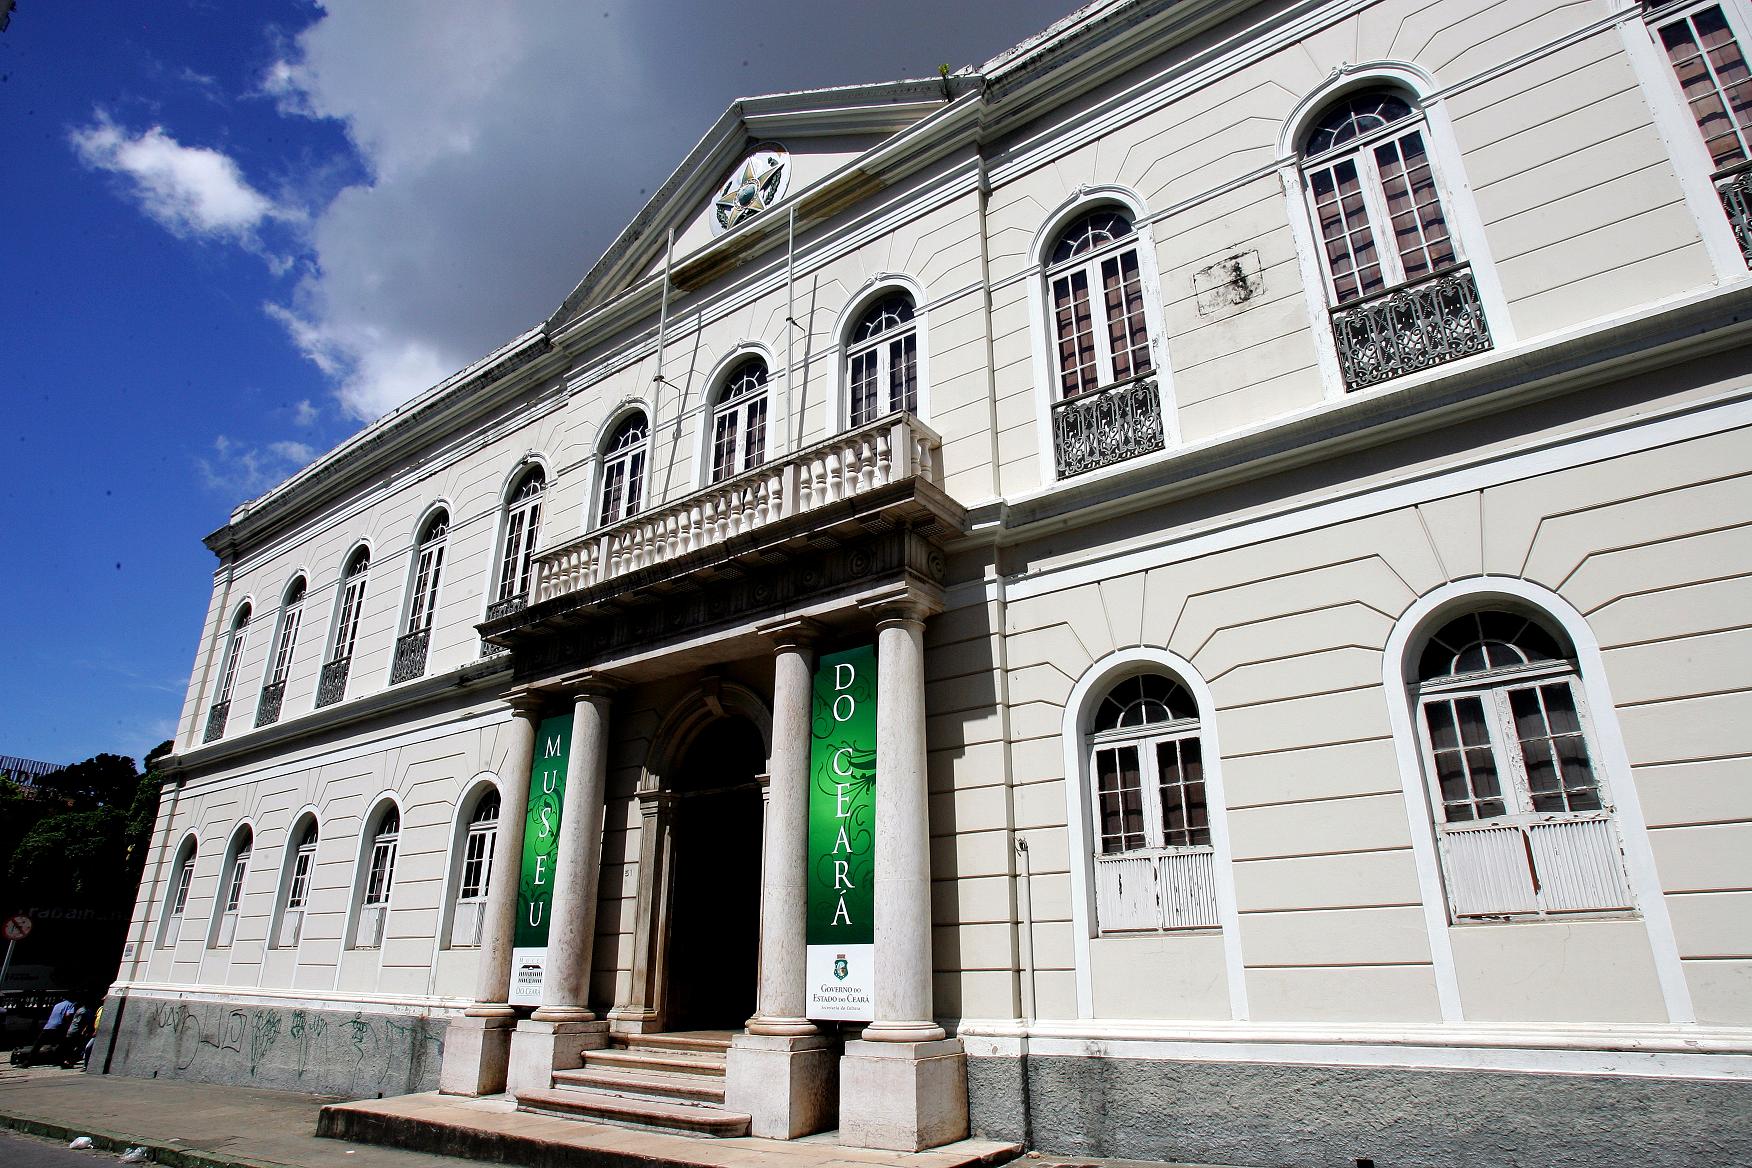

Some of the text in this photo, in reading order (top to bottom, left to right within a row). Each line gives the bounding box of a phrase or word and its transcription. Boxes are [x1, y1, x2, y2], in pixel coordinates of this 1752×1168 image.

[529, 734, 562, 927] MUSEU
[830, 662, 855, 927] DO CEARÁ
[813, 993, 838, 1002] ESTADO
[846, 993, 870, 1003] CEARÁ
[820, 984, 853, 993] GOVERNO
